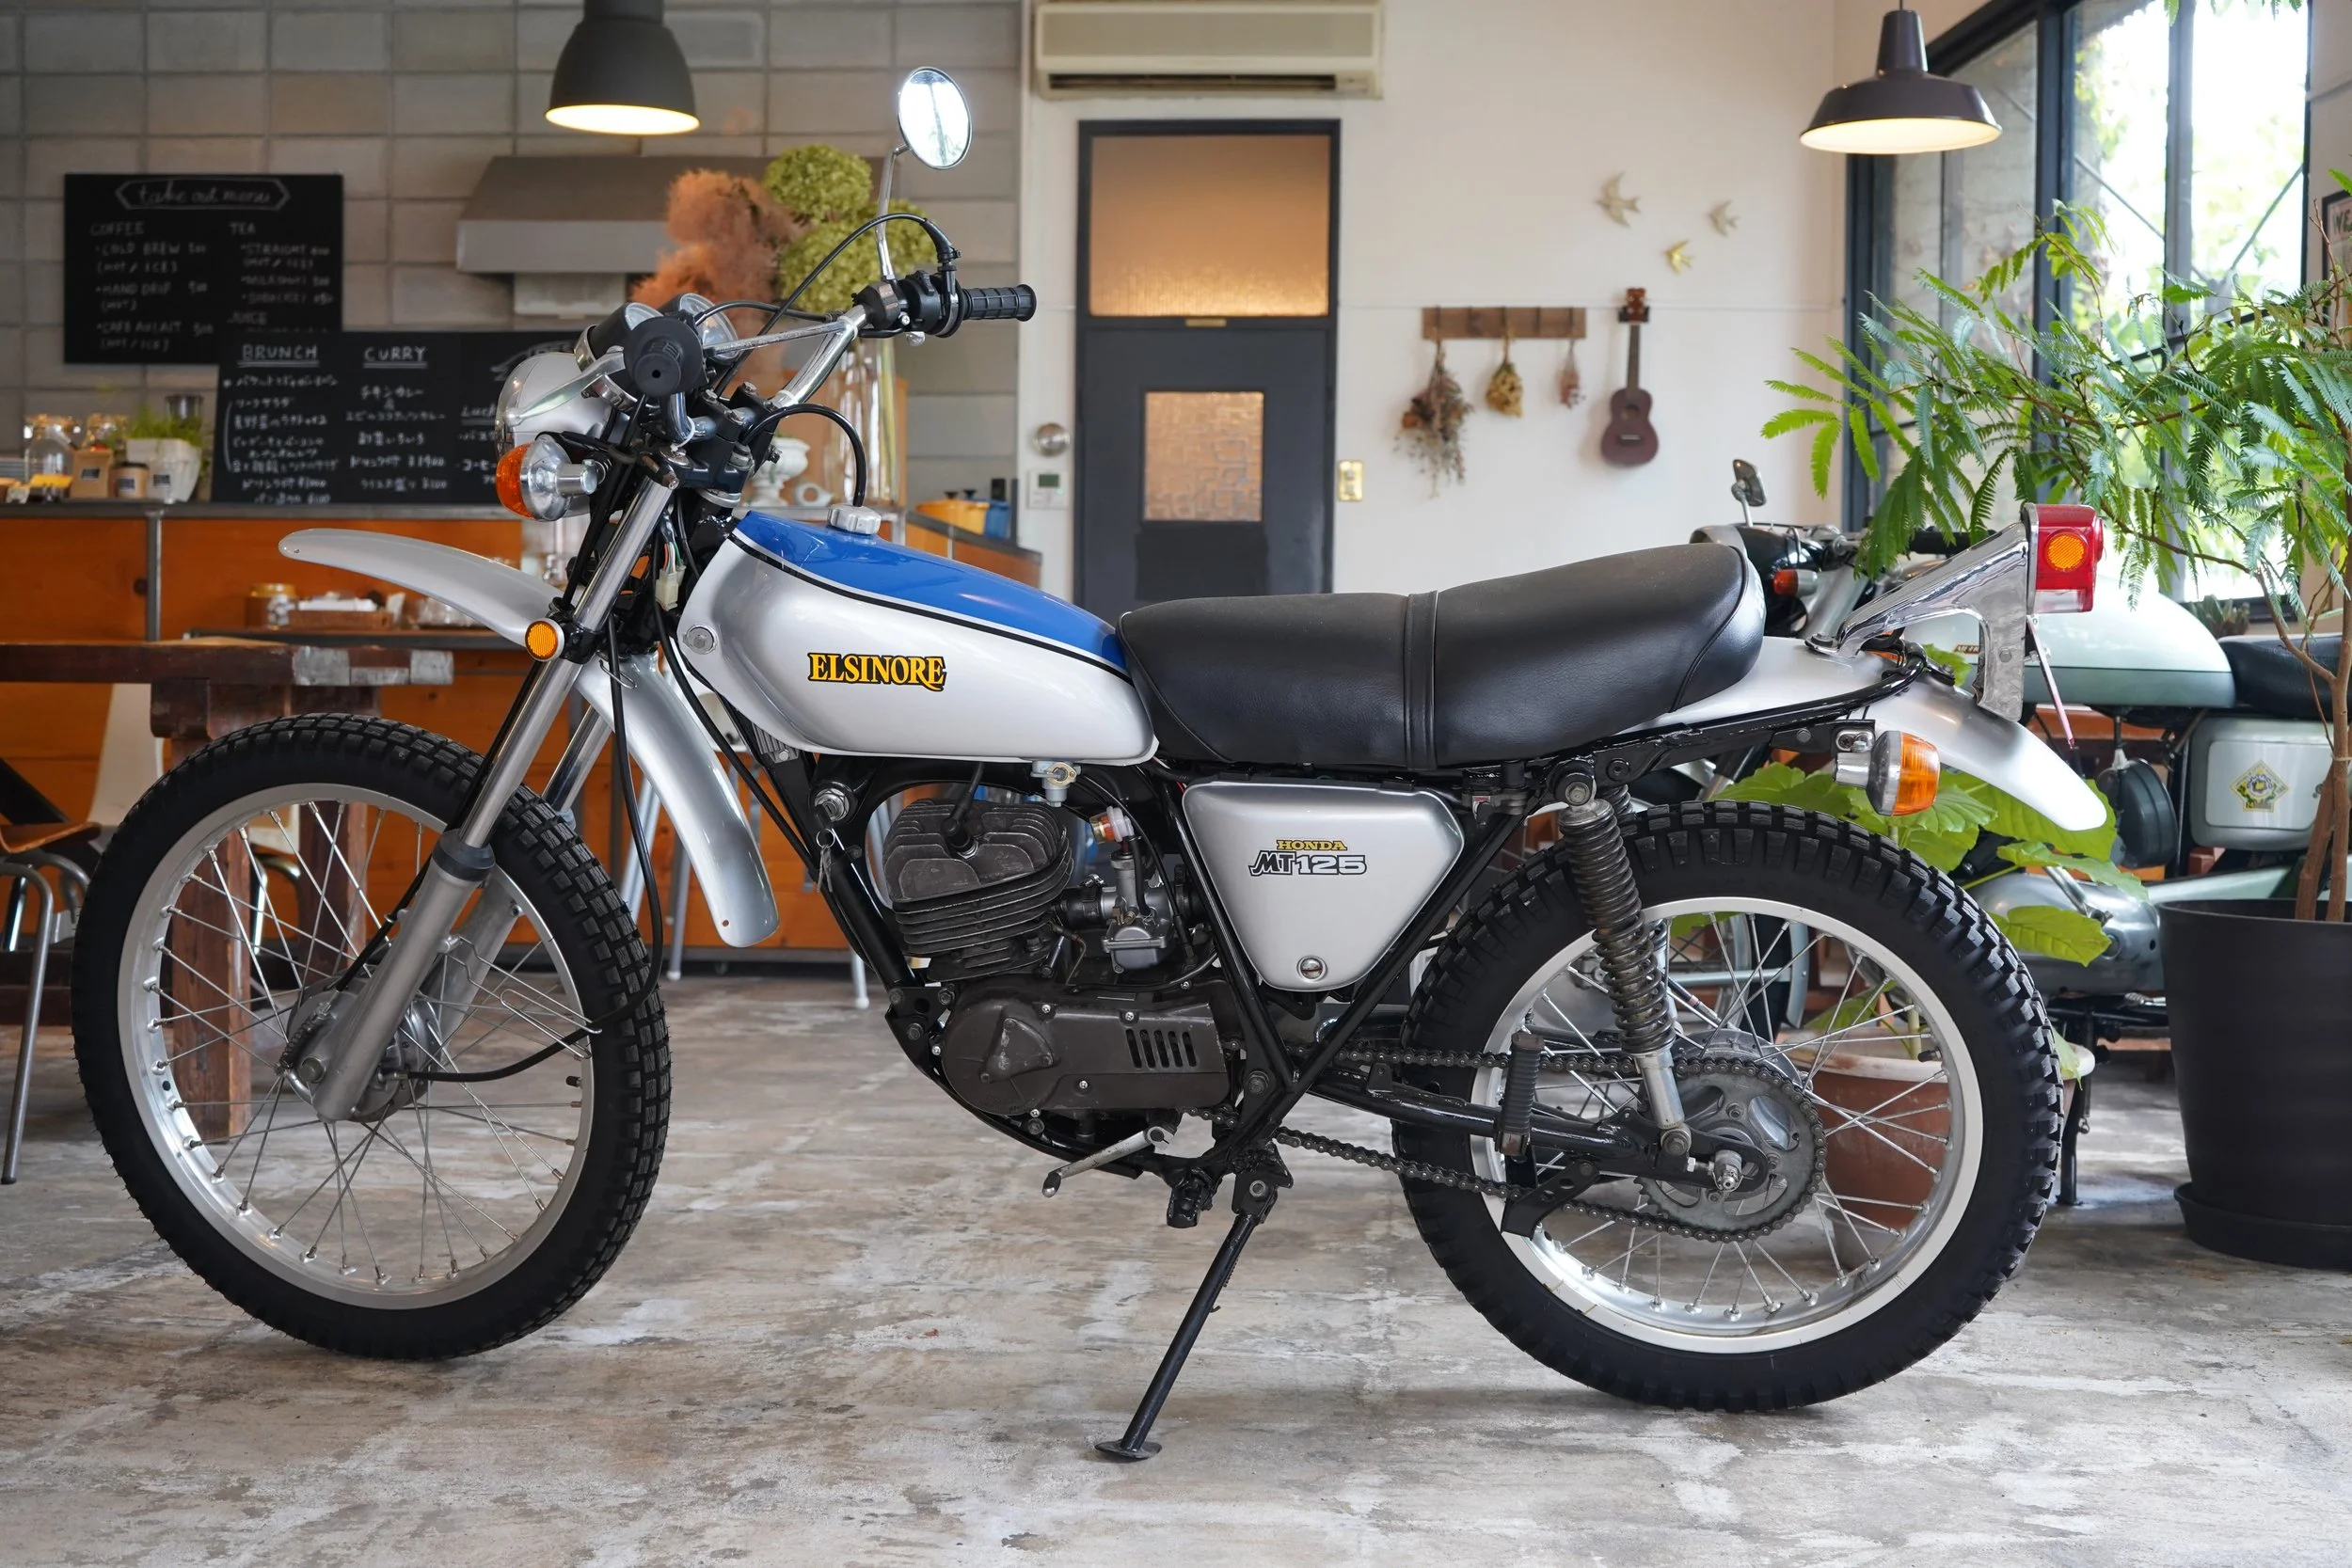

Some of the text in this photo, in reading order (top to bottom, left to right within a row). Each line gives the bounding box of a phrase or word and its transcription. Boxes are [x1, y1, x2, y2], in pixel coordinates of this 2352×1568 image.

[89, 221, 145, 236] COFFEE
[229, 222, 257, 236] TEA
[142, 241, 182, 256] BREW
[140, 281, 172, 296] DRIP
[227, 311, 269, 325] JUICE
[241, 343, 318, 360] BRUNCH
[363, 345, 428, 362] CURRY
[807, 653, 946, 691] ELSINORE
[1277, 840, 1347, 851] HONDA
